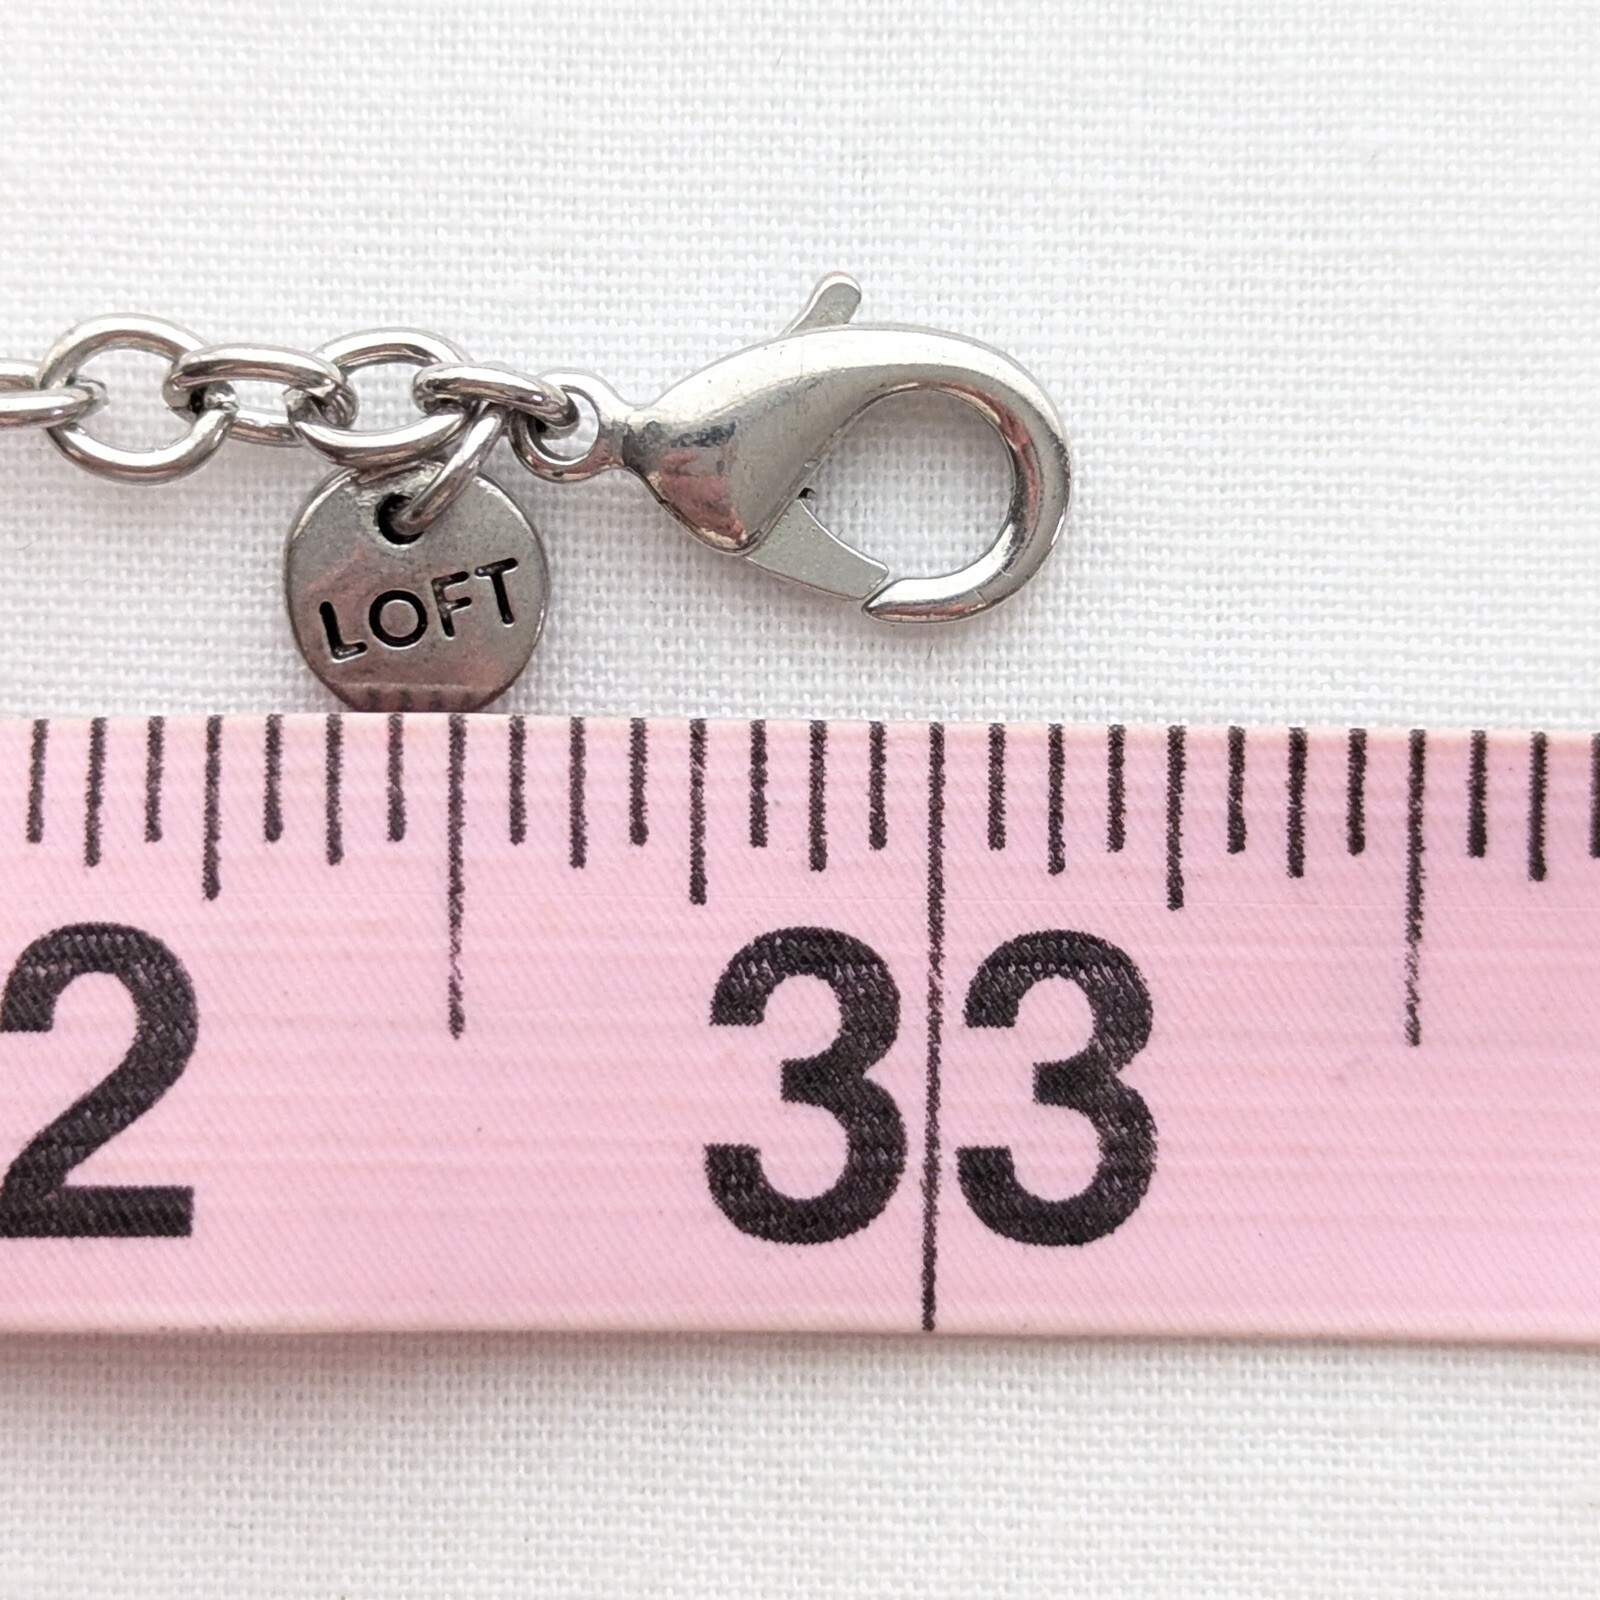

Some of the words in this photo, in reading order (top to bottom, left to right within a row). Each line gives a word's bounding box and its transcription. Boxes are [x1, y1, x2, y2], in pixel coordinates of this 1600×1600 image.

[318, 556, 519, 661] LOFT
[0, 922, 198, 1239] 2
[704, 926, 1159, 1248] 33
